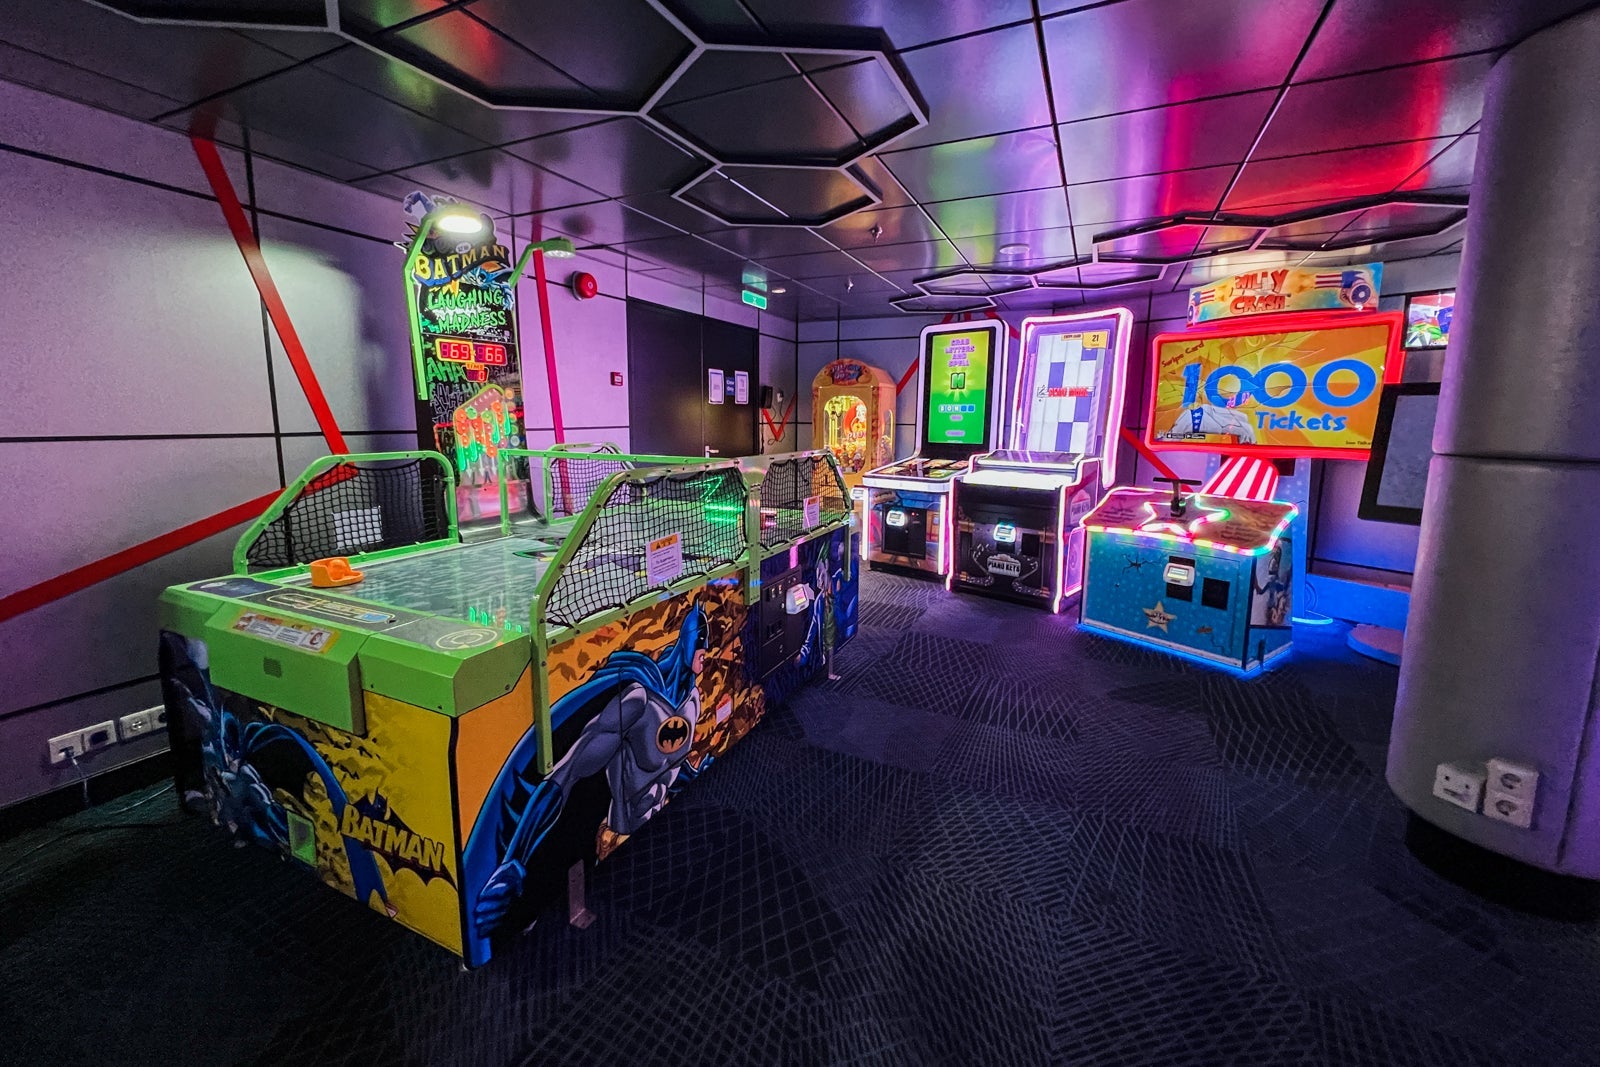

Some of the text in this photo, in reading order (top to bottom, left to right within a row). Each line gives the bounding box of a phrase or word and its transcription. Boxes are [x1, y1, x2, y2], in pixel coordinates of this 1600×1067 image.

[415, 244, 505, 280] BATMAN
[427, 289, 504, 311] LAUGHING
[1229, 294, 1286, 315] CRASH
[438, 310, 507, 334] MADNESS
[1091, 334, 1100, 342] 21
[1161, 340, 1205, 368] Swipe Card
[1182, 359, 1377, 408] 1000
[1256, 411, 1348, 432] Tickets
[340, 803, 445, 872] BATMAN
